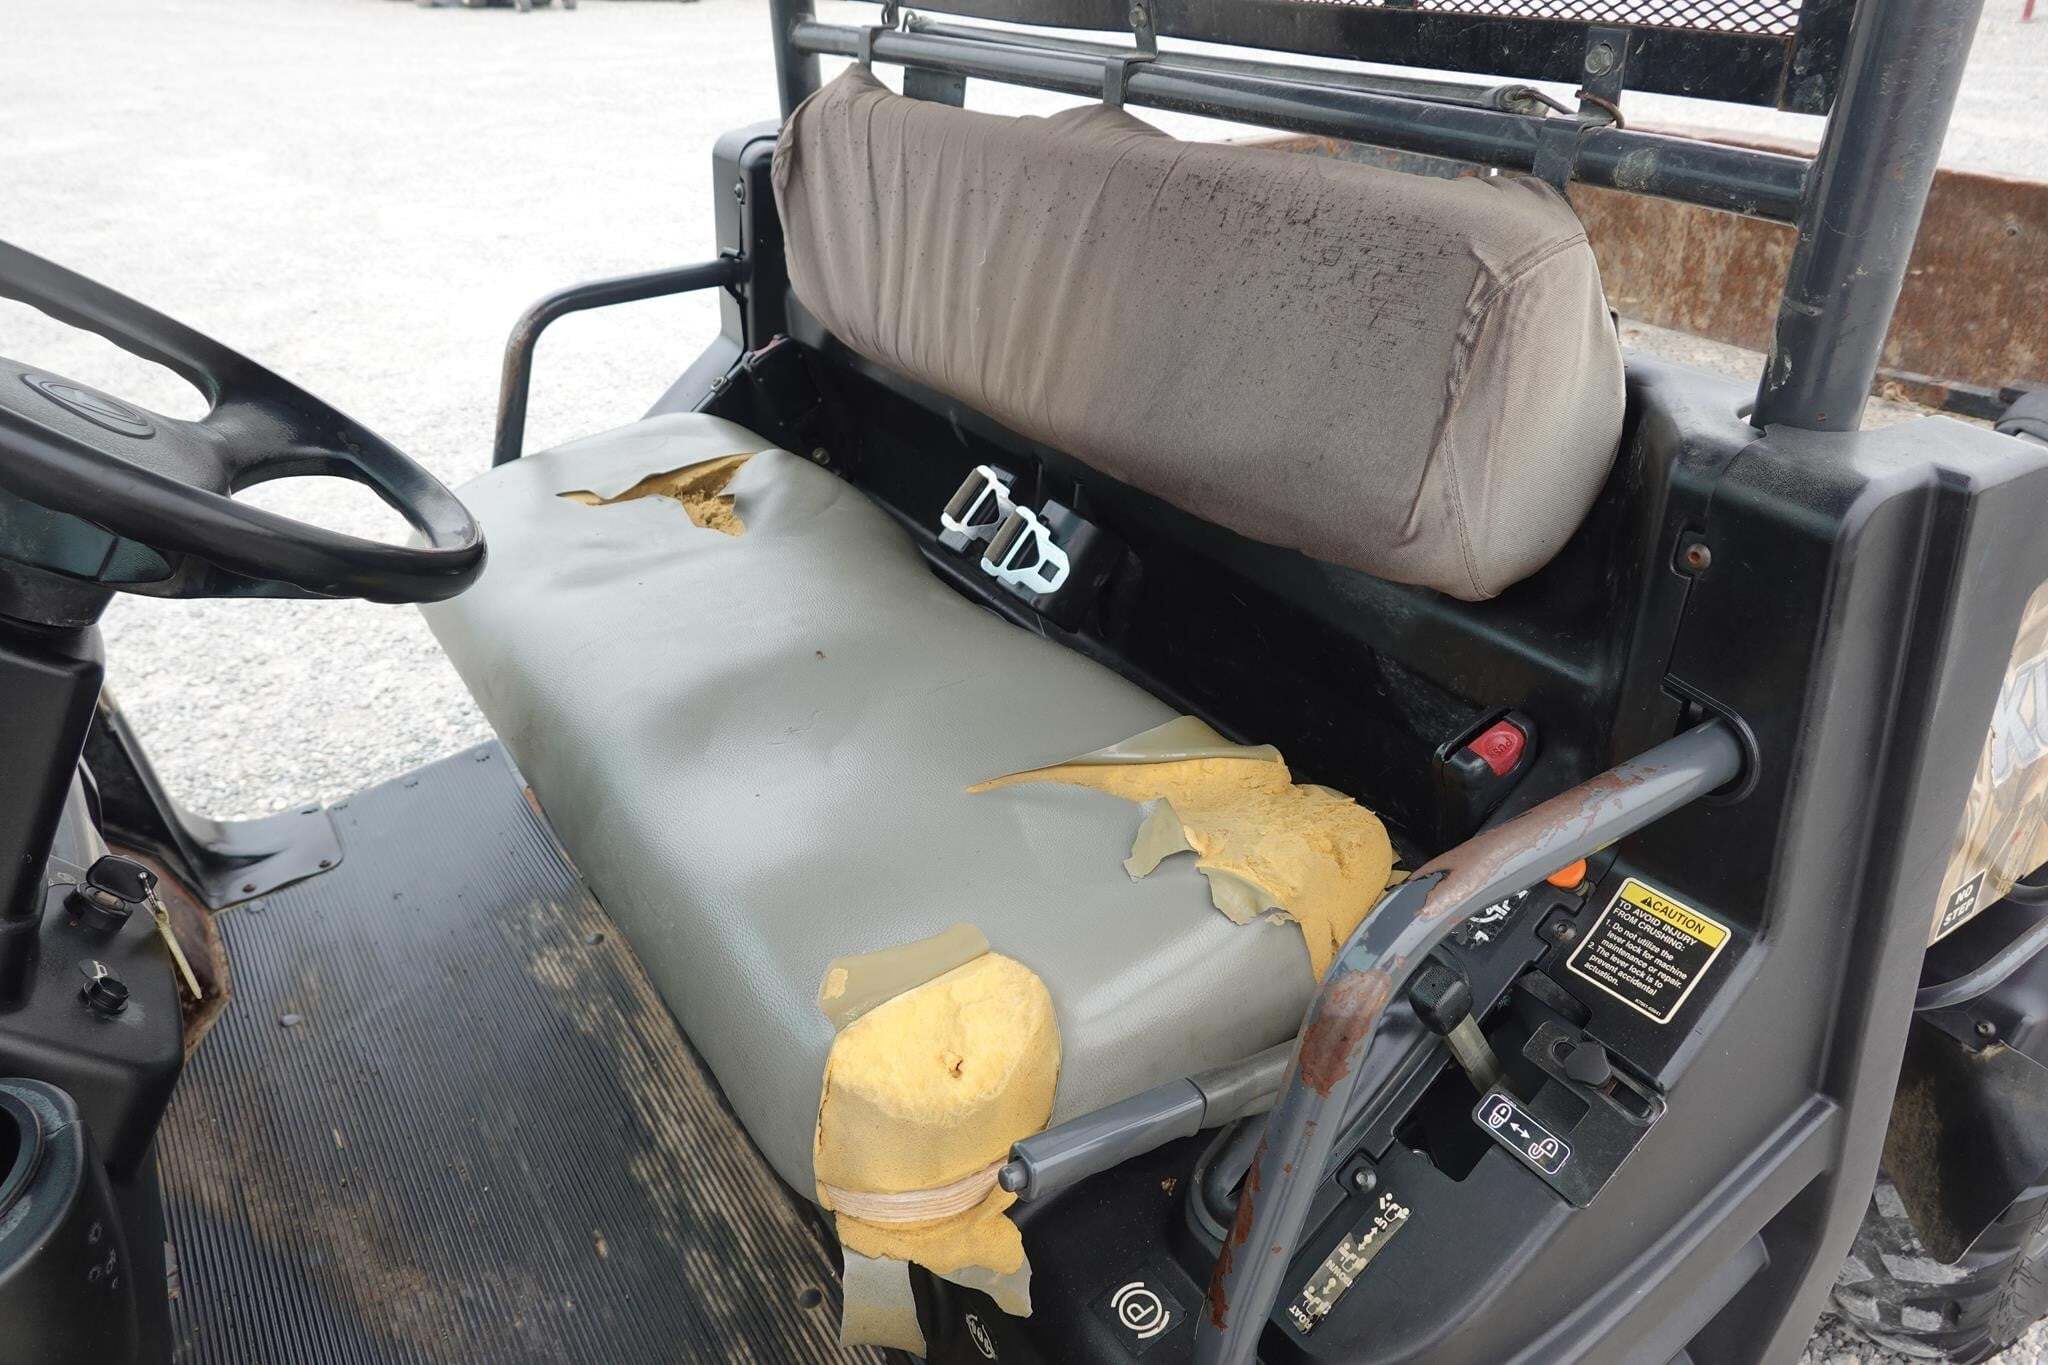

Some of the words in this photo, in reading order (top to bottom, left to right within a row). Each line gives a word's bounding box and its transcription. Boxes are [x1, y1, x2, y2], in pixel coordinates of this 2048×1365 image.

[1955, 884, 1973, 905] NO
[1619, 899, 1632, 910] TO
[1632, 908, 1661, 927] AVOID
[1662, 923, 1698, 946] INJURY
[1650, 901, 1705, 934] CAUTION
[1943, 897, 1975, 926] STEP
[1606, 919, 1611, 927] 1.
[1612, 922, 1624, 933] Do
[1623, 930, 1638, 941] not
[1637, 937, 1660, 953] utilize
[1660, 949, 1674, 961] the
[1612, 907, 1639, 925] FROM
[1638, 921, 1685, 952] CRUSHING:
[1587, 941, 1595, 950] 2.
[1596, 945, 1610, 958] The
[1609, 954, 1629, 968] lever
[1628, 964, 1646, 978] lock
[1645, 974, 1654, 983] is
[1654, 979, 1663, 988] to
[1601, 939, 1648, 968] maintenance
[1648, 966, 1658, 974] or
[1657, 971, 1682, 989] repair.
[1607, 930, 1626, 944] lever
[1625, 941, 1642, 954] lock
[1642, 950, 1654, 960] for
[1654, 958, 1687, 980] machine
[1584, 962, 1618, 986] actuation.
[1589, 954, 1618, 973] prevent
[1617, 970, 1658, 996] accidental
[1373, 1216, 1389, 1230] UP
[1326, 1259, 1353, 1287] DOWN
[1126, 1302, 1155, 1323] P
[1288, 1304, 1313, 1330] FLOAT
